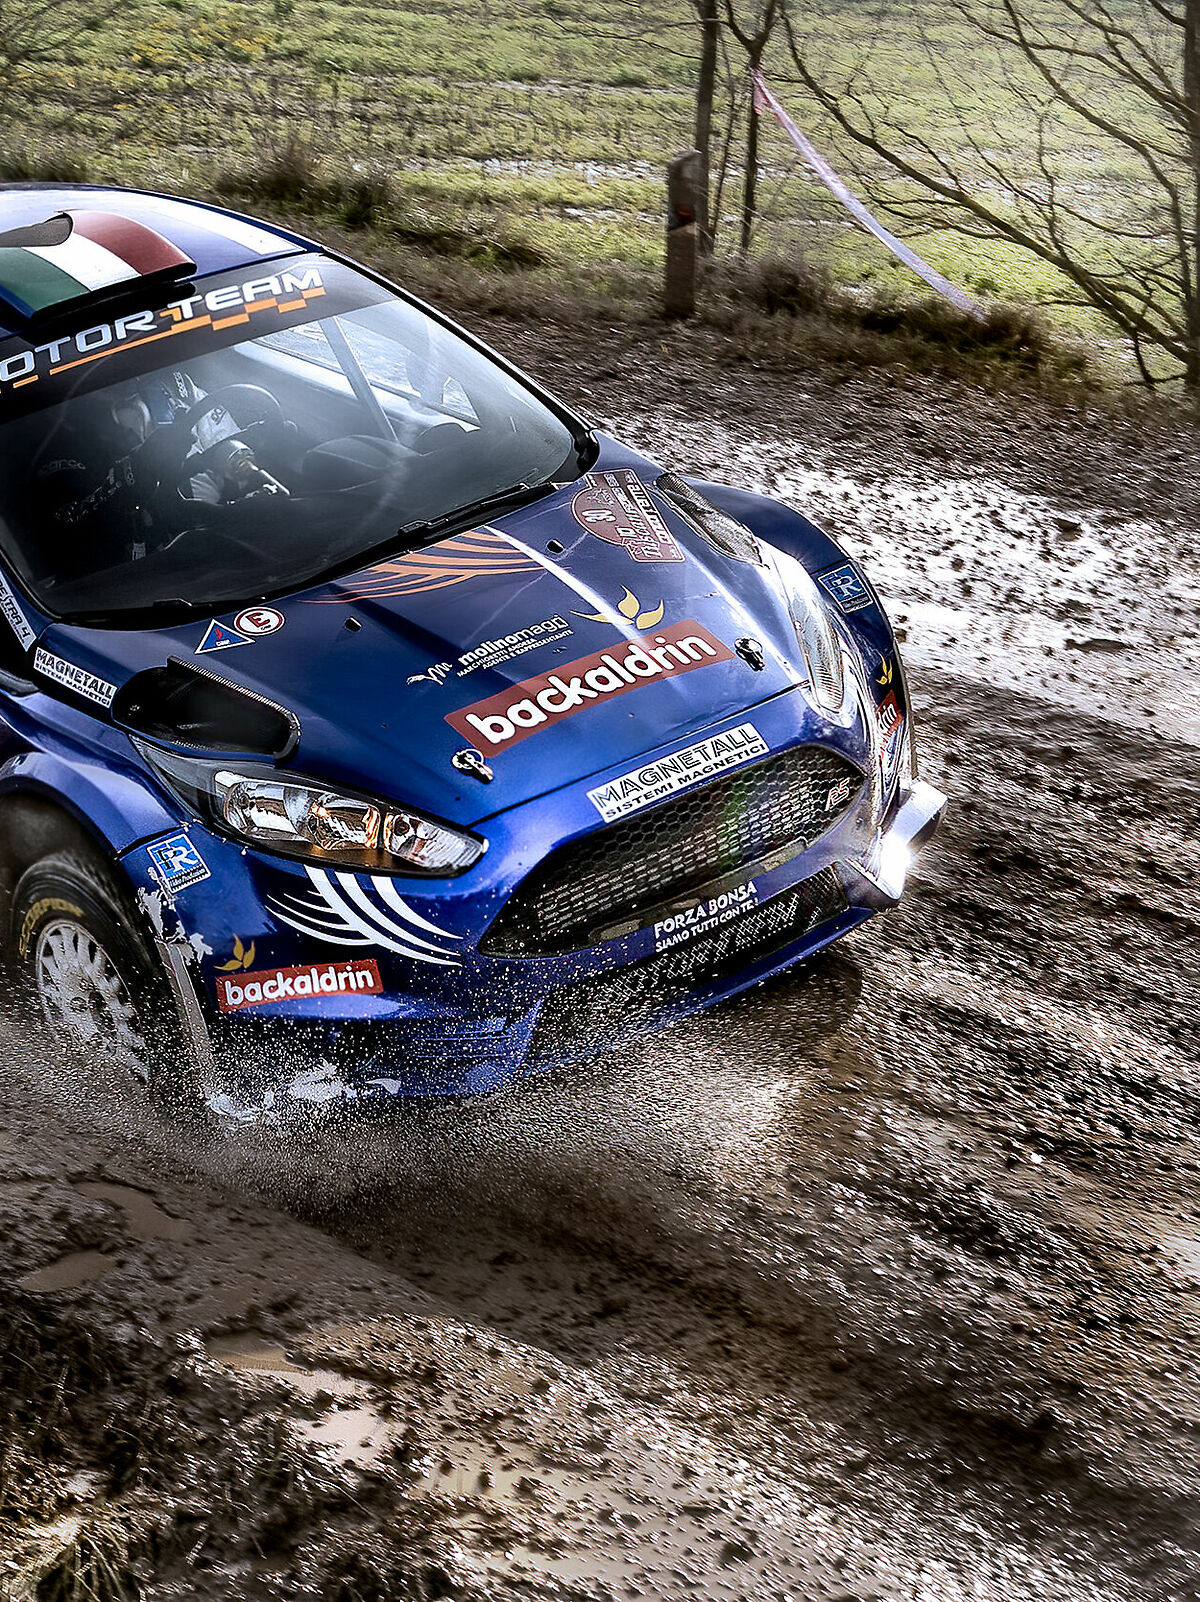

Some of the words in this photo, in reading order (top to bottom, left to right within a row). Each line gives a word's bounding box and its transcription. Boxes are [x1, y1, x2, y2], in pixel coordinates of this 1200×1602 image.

[167, 268, 324, 319] TEAM
[21, 627, 32, 638] 4
[245, 612, 271, 628] E
[458, 614, 569, 666] molinomagri
[35, 662, 66, 683] SISTEMI
[65, 678, 110, 706] MAGNETICI
[36, 649, 114, 700] MAGNETALL
[465, 632, 719, 745] backaldrin
[595, 726, 761, 809] MAGNETALL
[605, 781, 674, 818] SISTEMI
[678, 743, 767, 786] MAGNETICI
[654, 905, 707, 939] FORZA
[708, 880, 757, 916] BONSA
[655, 929, 690, 953] SIAMO
[690, 916, 719, 936] TUTTI
[719, 906, 740, 923] CON
[225, 964, 375, 1006] backaldrin
